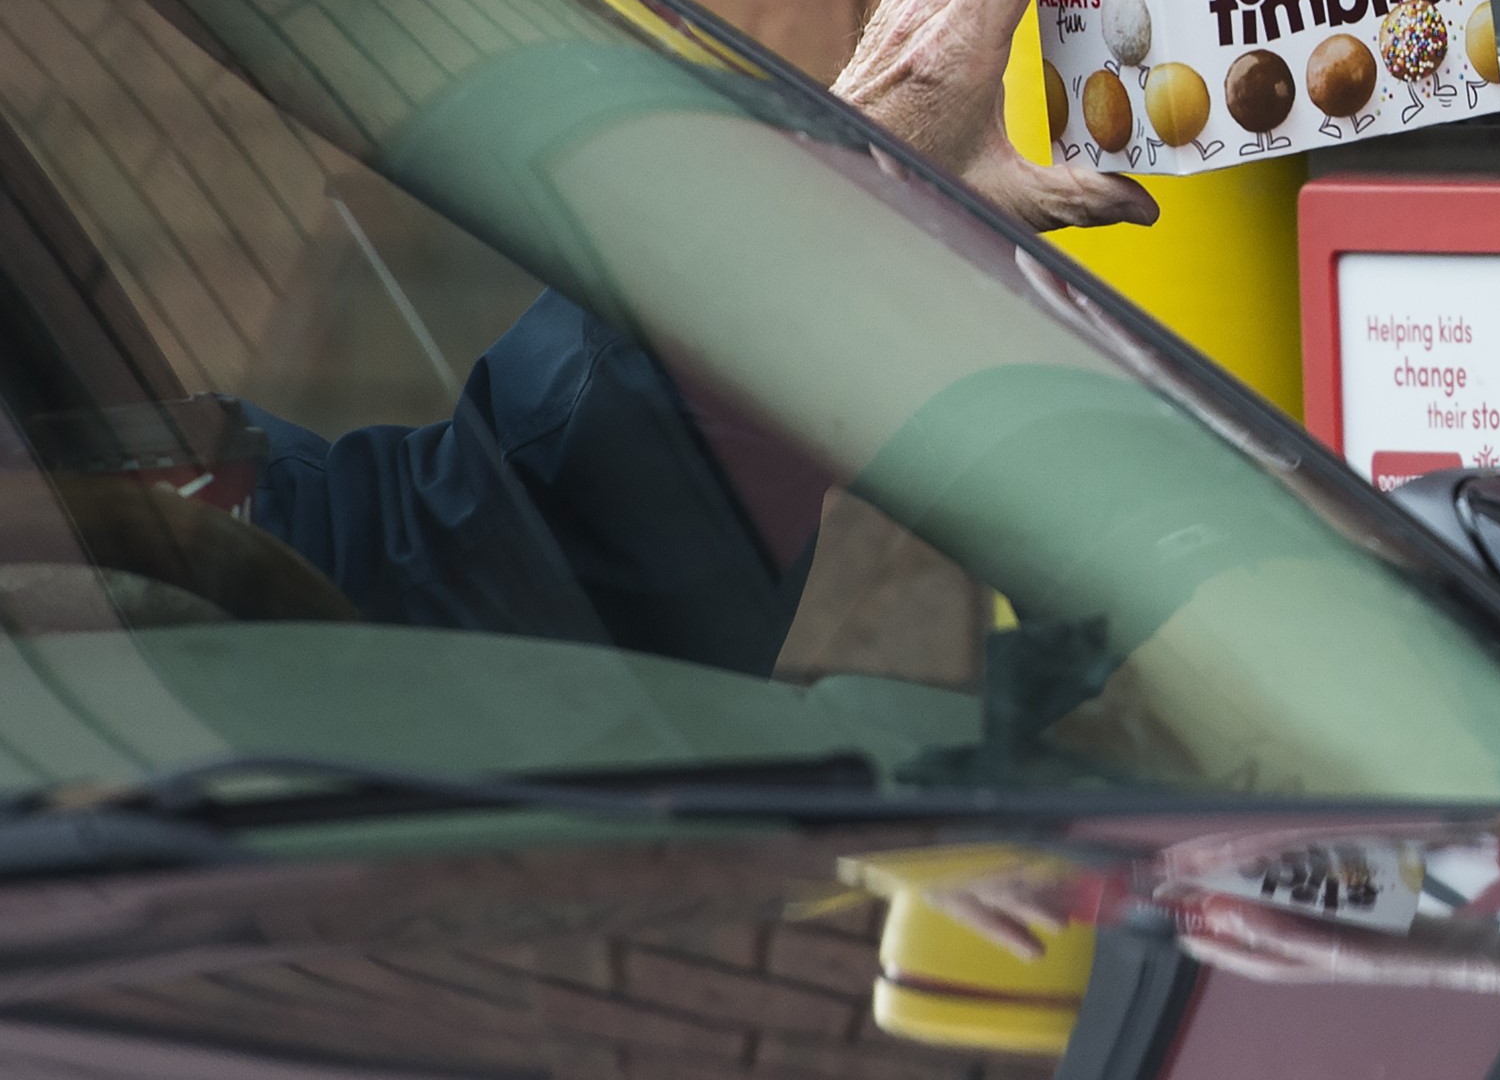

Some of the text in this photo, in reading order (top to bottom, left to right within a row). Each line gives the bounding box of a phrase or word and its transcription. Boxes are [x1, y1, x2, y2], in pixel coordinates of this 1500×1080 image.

[1056, 5, 1087, 44] fun
[1367, 315, 1473, 351] Helping kids
[1394, 356, 1467, 397] change
[1427, 401, 1467, 430] their
